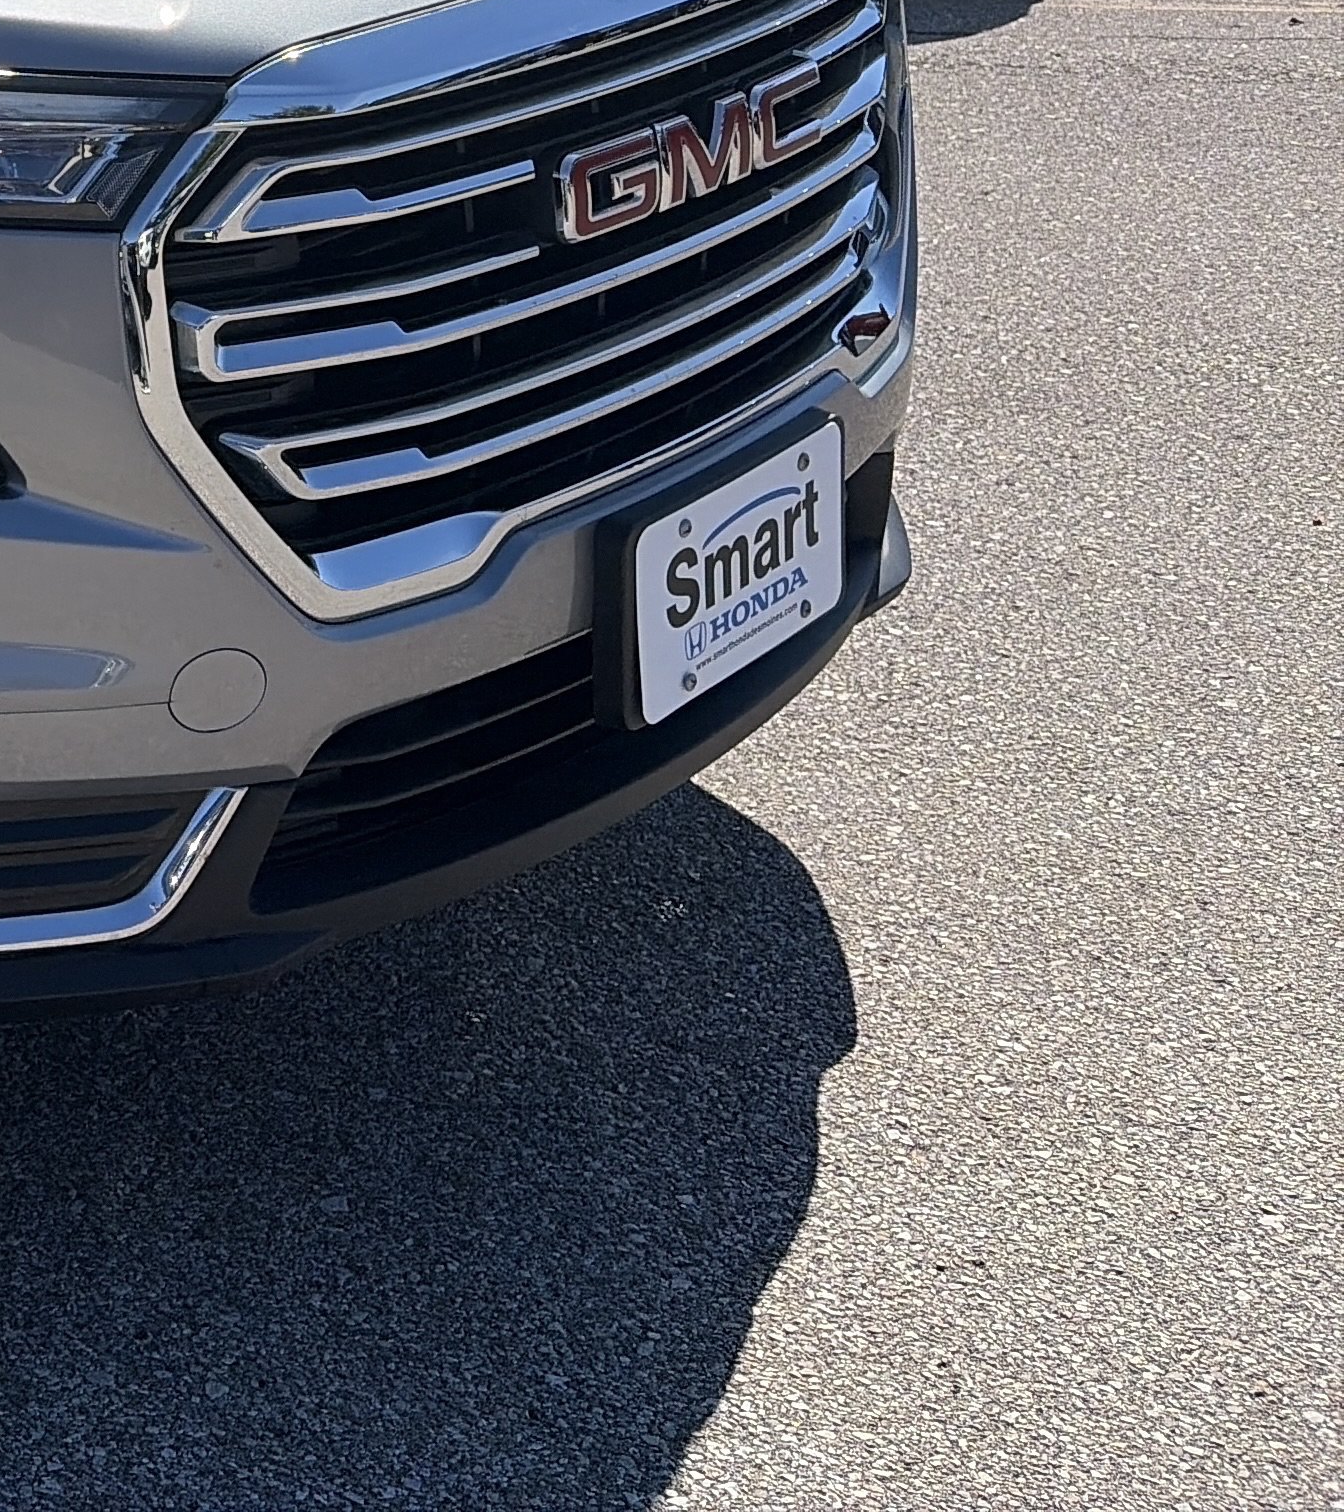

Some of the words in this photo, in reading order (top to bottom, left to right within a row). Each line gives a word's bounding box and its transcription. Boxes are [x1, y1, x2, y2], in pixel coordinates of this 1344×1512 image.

[558, 60, 822, 244] GMC
[666, 479, 819, 629] Smart
[709, 567, 808, 643] HONDA
[696, 602, 798, 670] www.smarthondadesmoines.com
